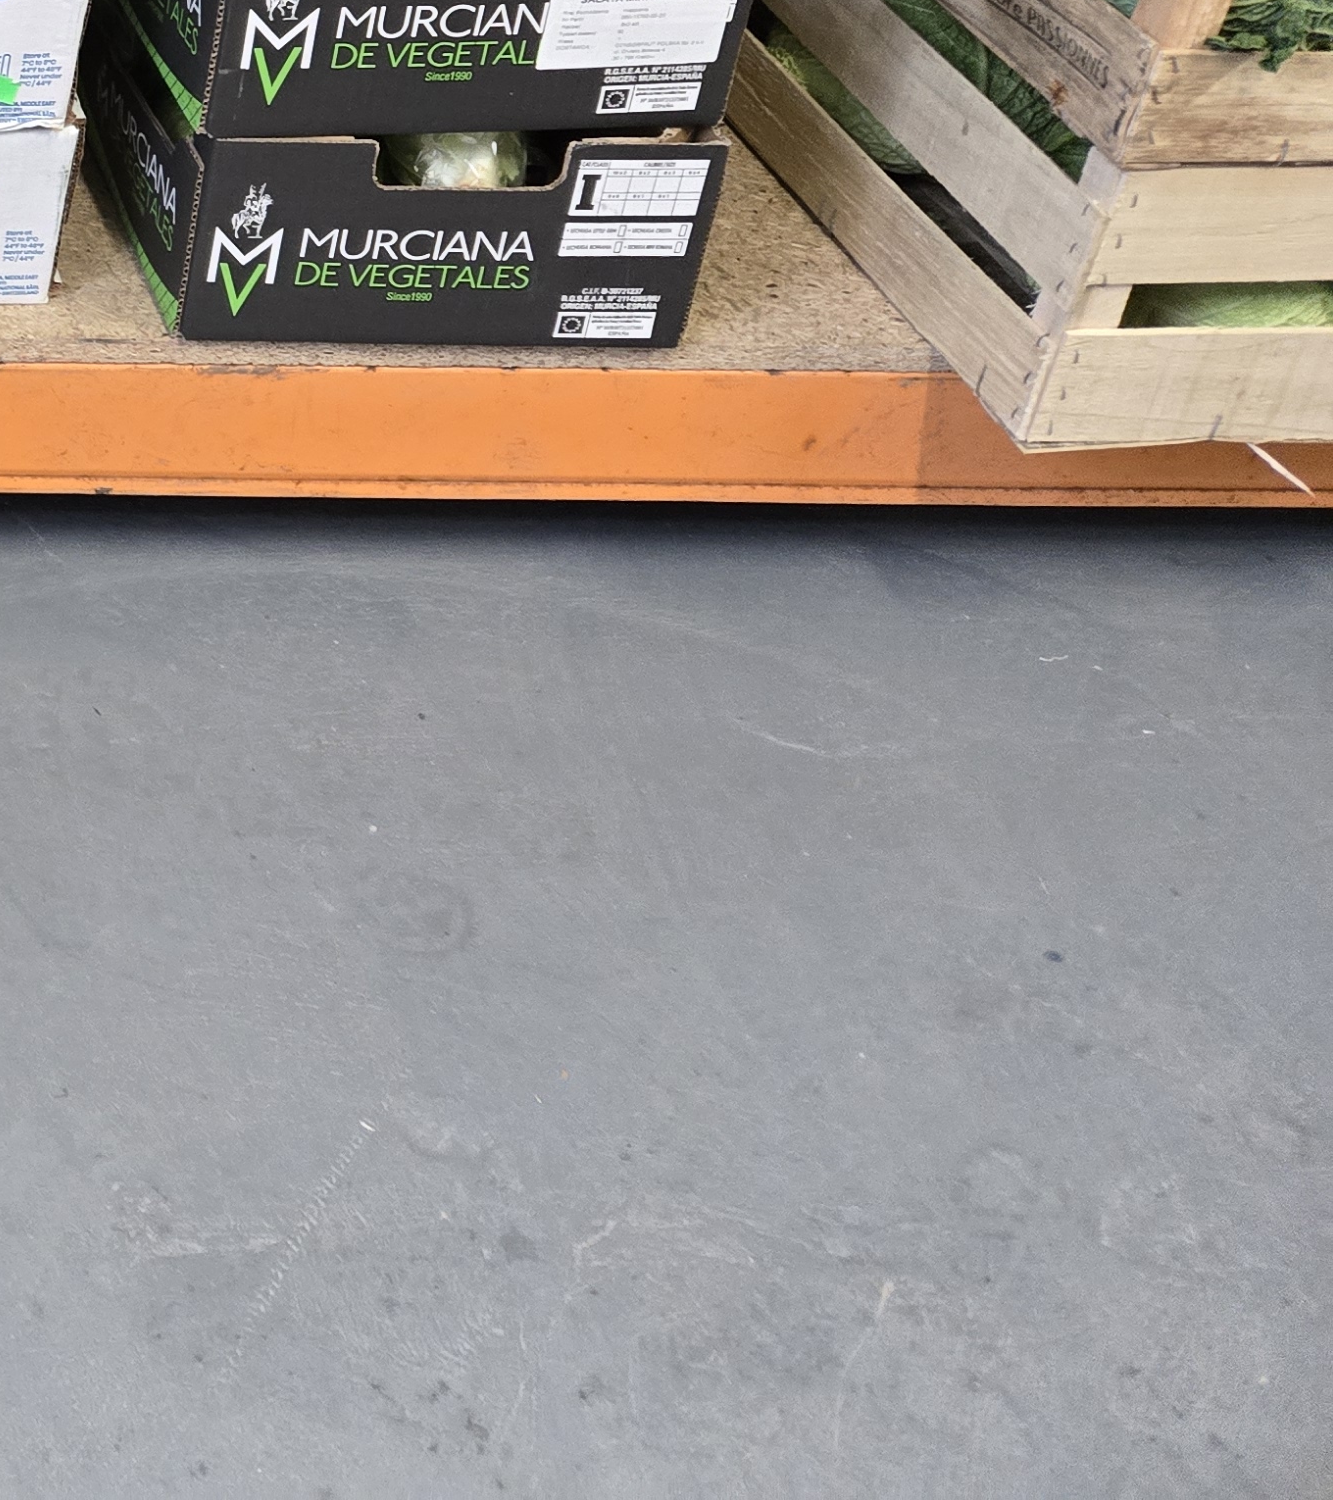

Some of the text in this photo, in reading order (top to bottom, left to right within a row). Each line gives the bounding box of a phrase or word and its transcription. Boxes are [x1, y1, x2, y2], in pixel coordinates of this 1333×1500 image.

[335, 3, 550, 39] MURCIAN
[331, 40, 536, 70] DE VEGETAL
[299, 228, 535, 262] MURCIANA
[294, 262, 531, 290] DE VEGETALES
